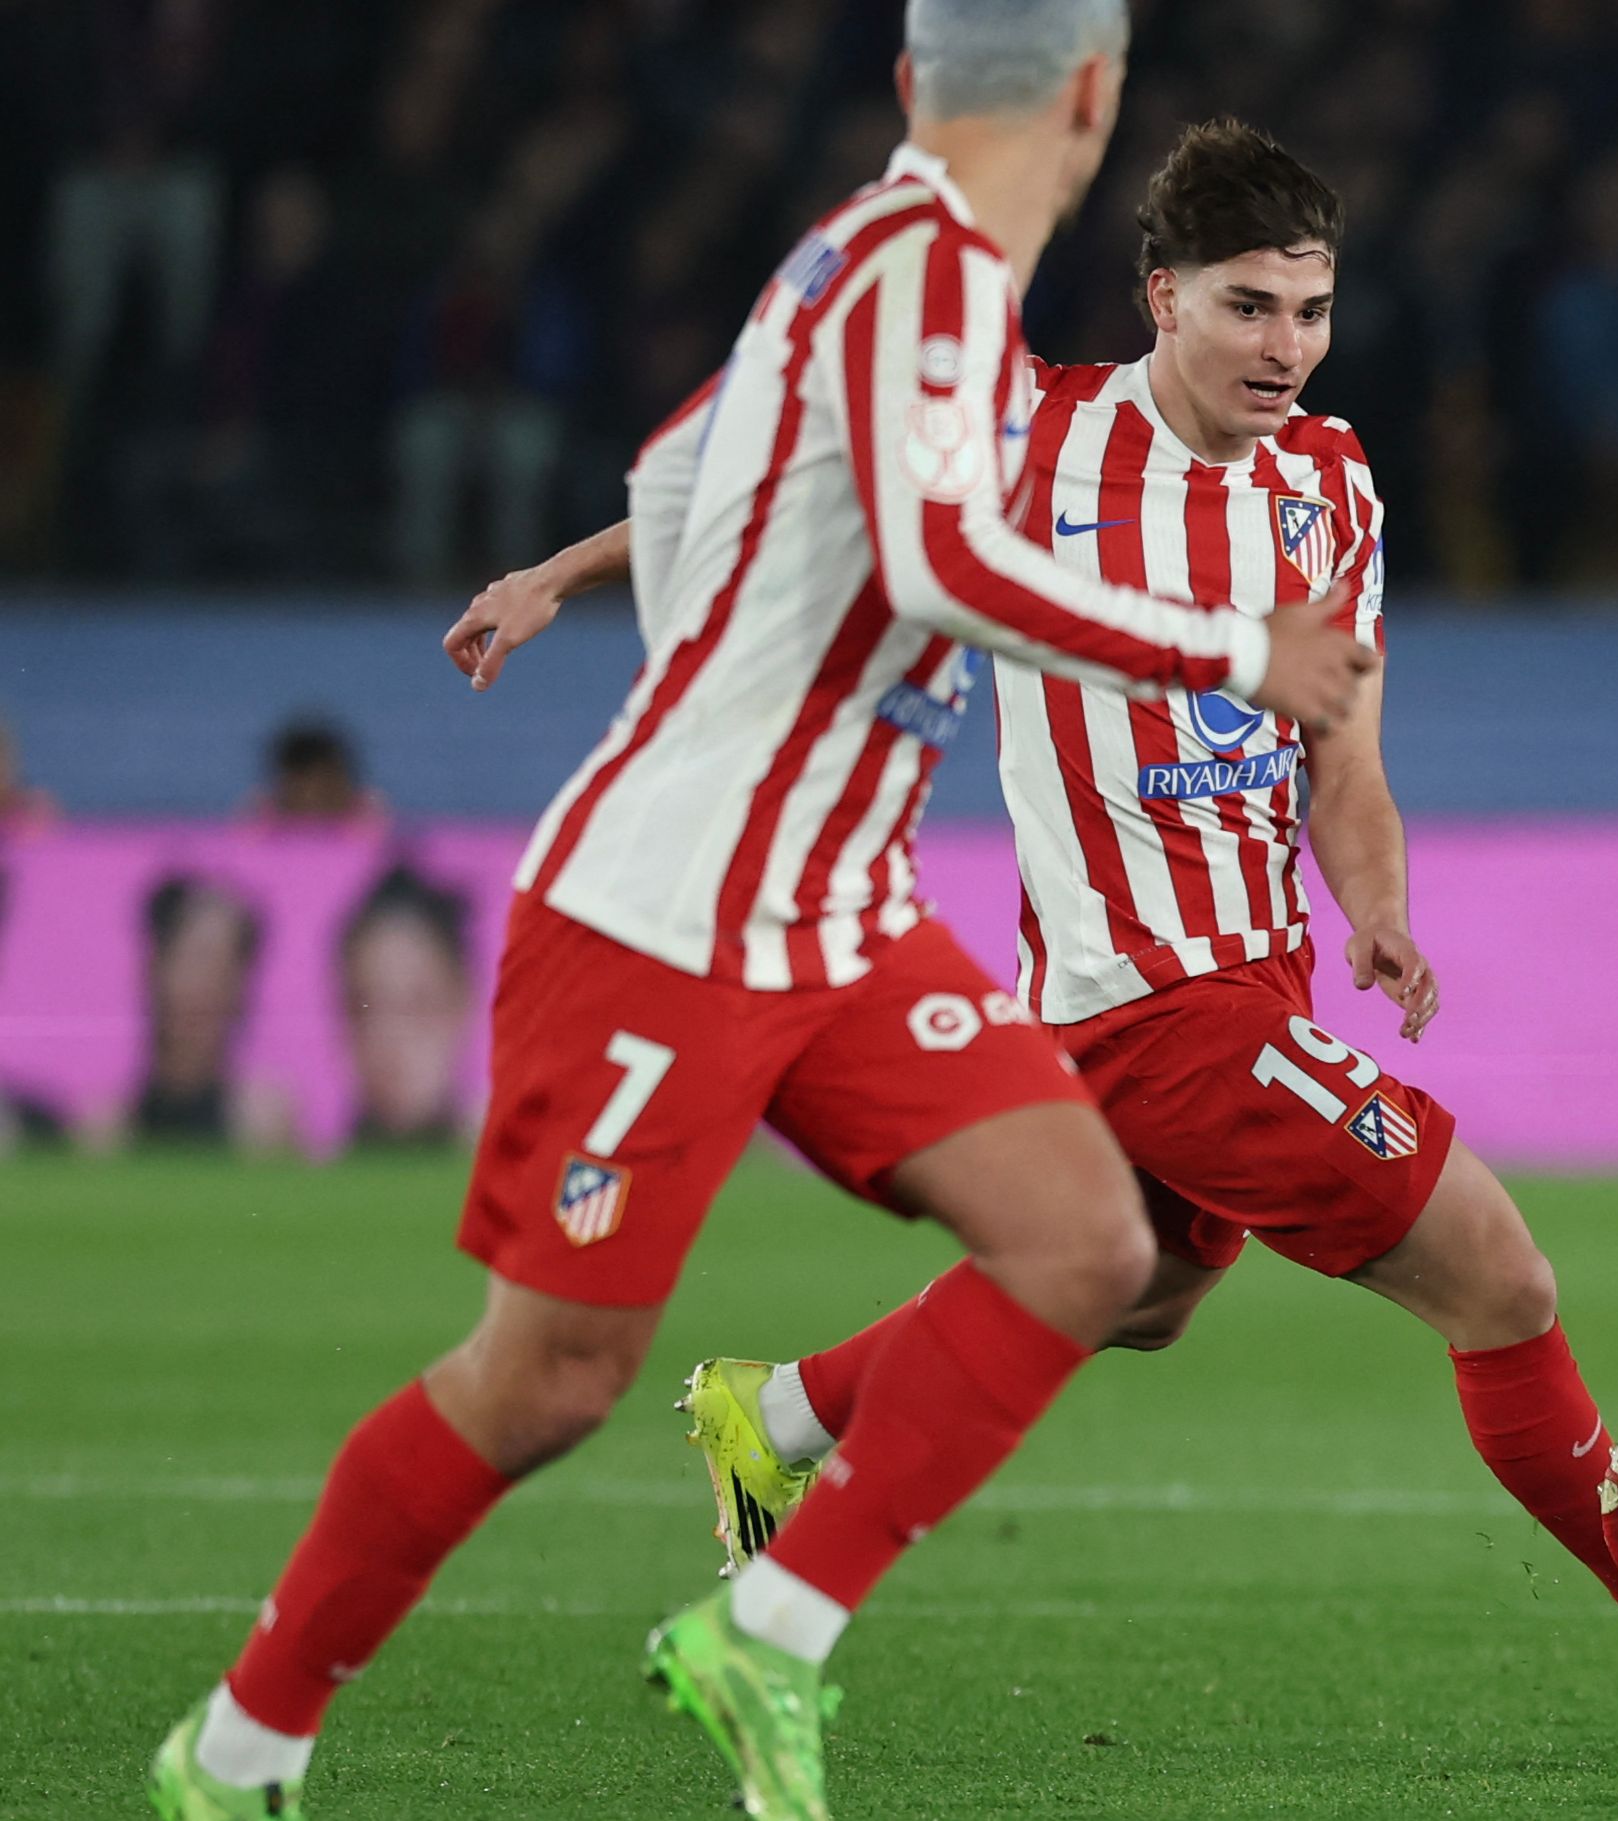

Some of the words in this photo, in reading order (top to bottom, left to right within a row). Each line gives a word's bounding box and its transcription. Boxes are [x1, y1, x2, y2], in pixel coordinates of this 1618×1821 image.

[1147, 760, 1256, 796] RIYADH
[1260, 747, 1295, 786] AIR
[583, 1028, 677, 1159] 7
[1250, 1014, 1381, 1125] 19
